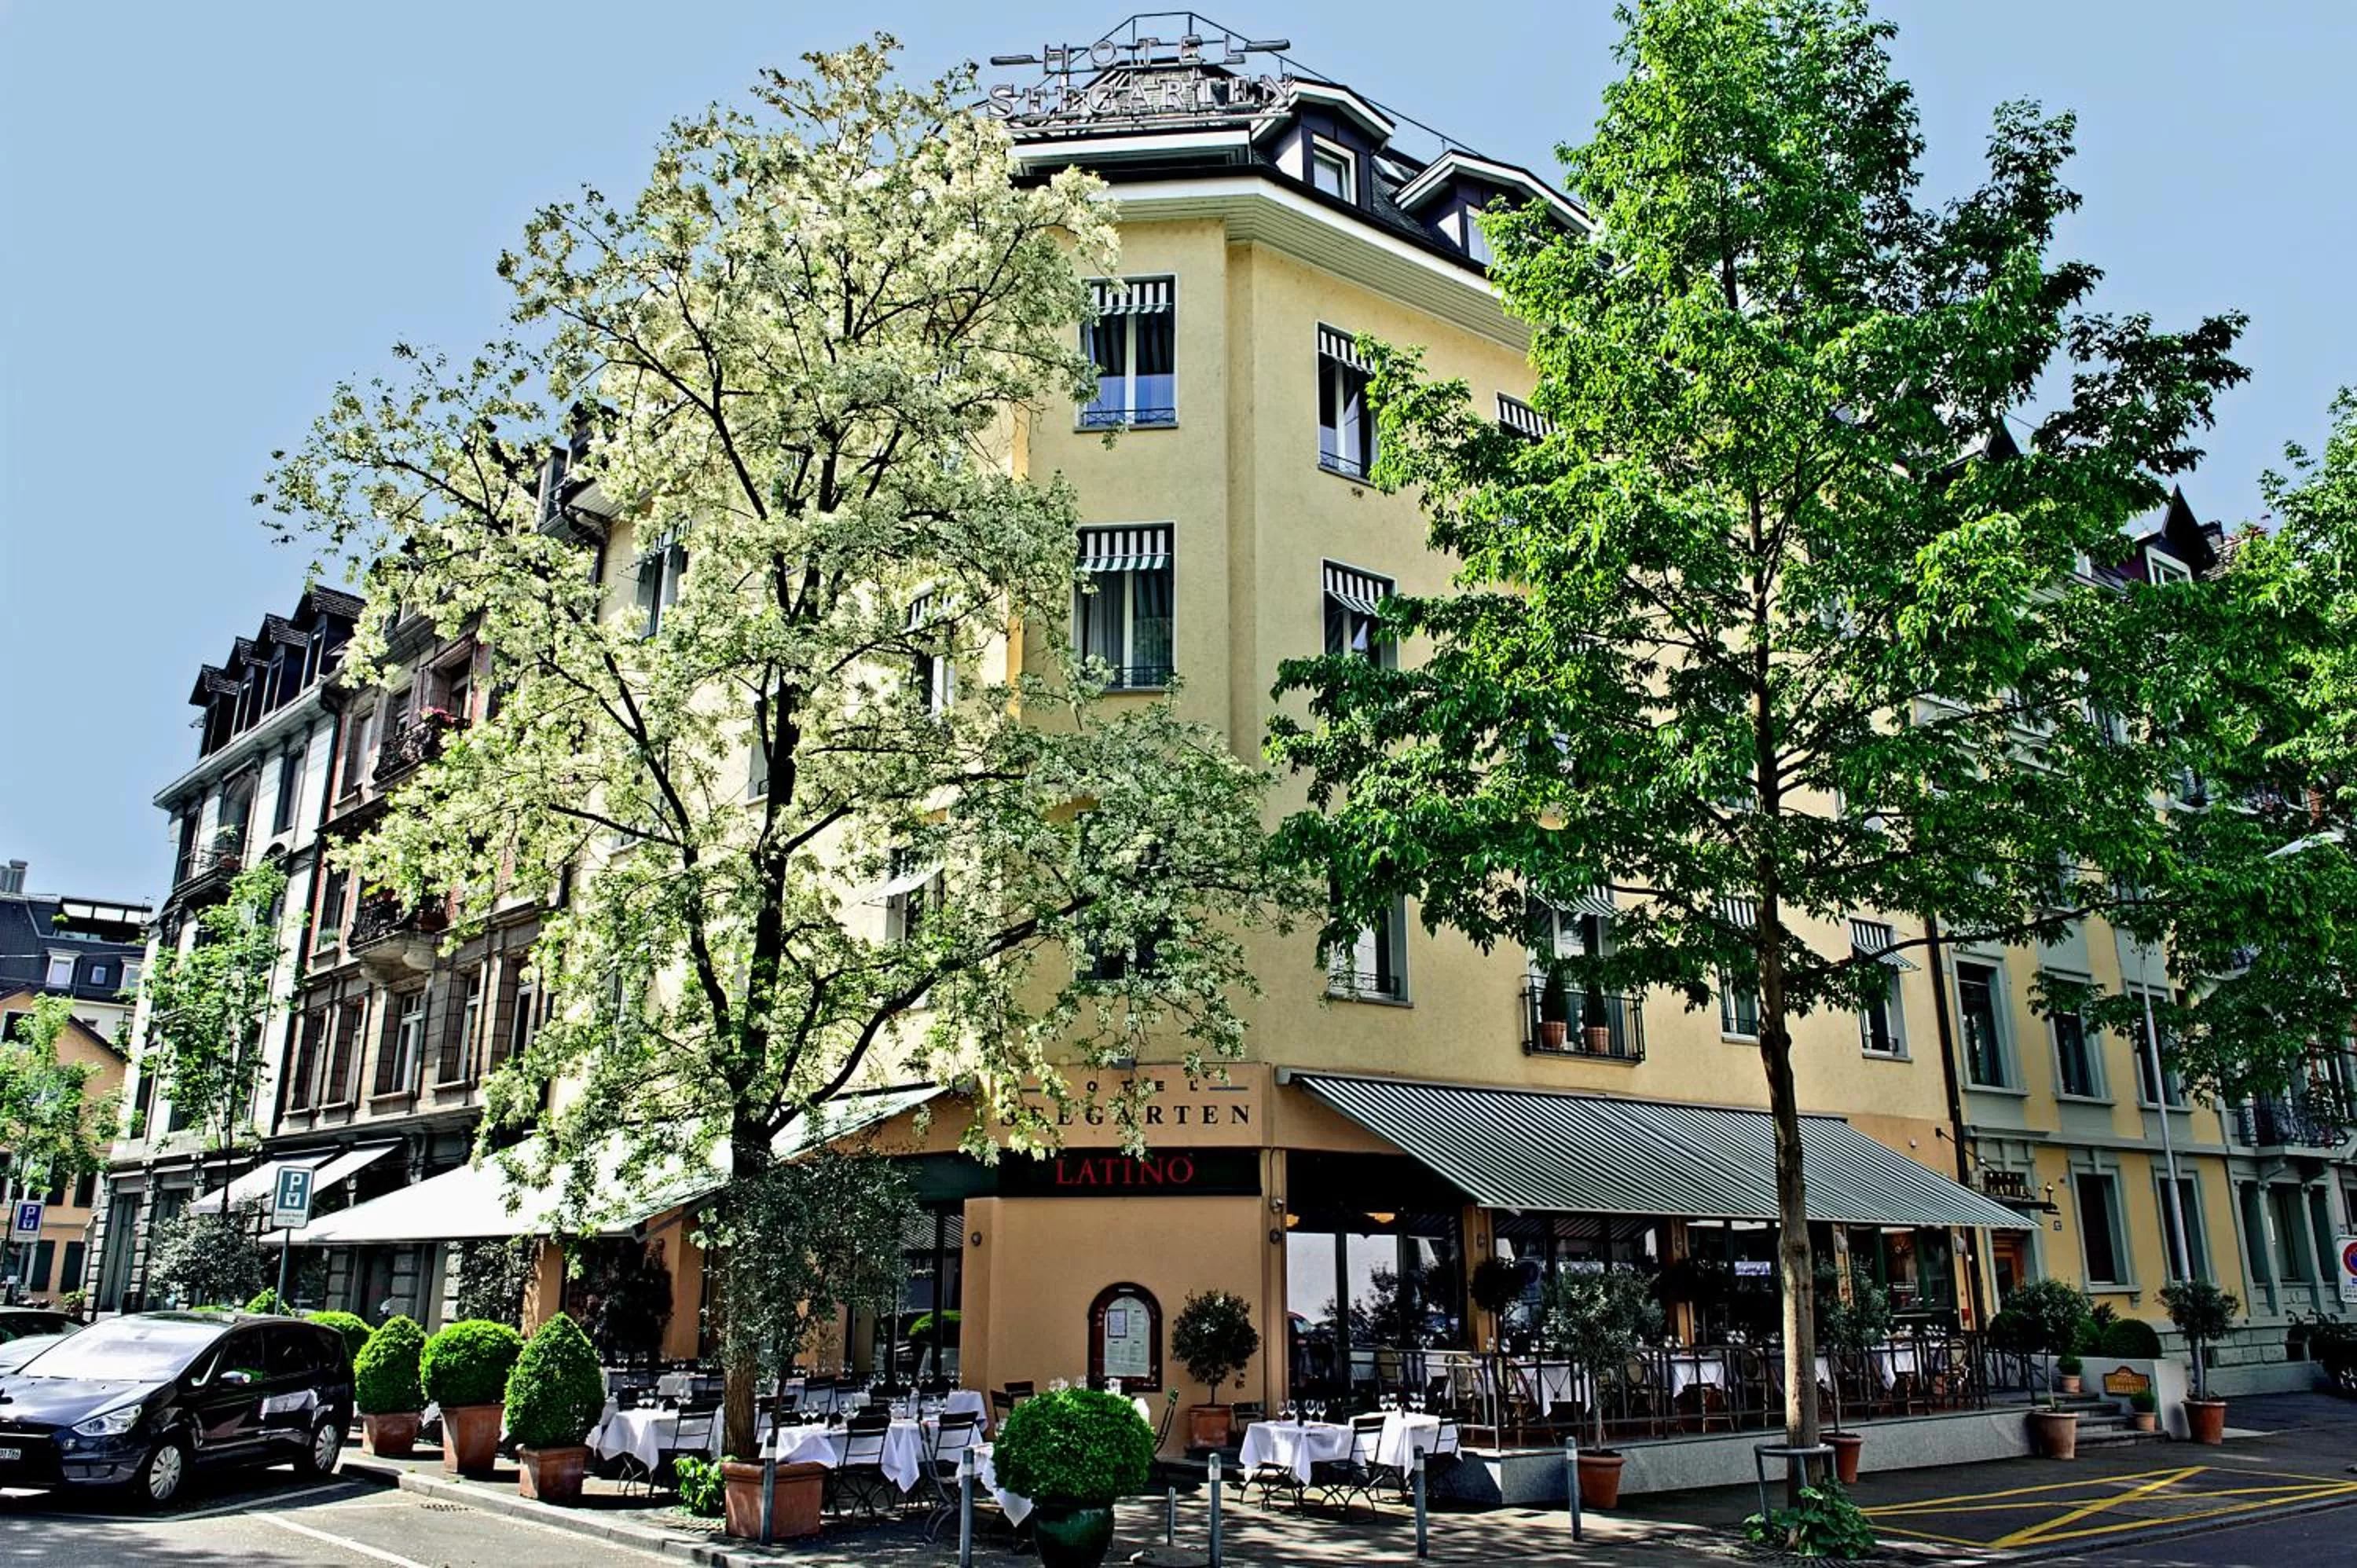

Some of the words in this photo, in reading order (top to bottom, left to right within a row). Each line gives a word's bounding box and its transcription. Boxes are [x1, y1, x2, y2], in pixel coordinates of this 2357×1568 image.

[1043, 34, 1247, 75] HOTEL
[988, 72, 1292, 120] SEEGARTEN
[1051, 1079, 1198, 1093] OTEL
[288, 1173, 303, 1192] P
[1055, 1156, 1194, 1185] LATINO
